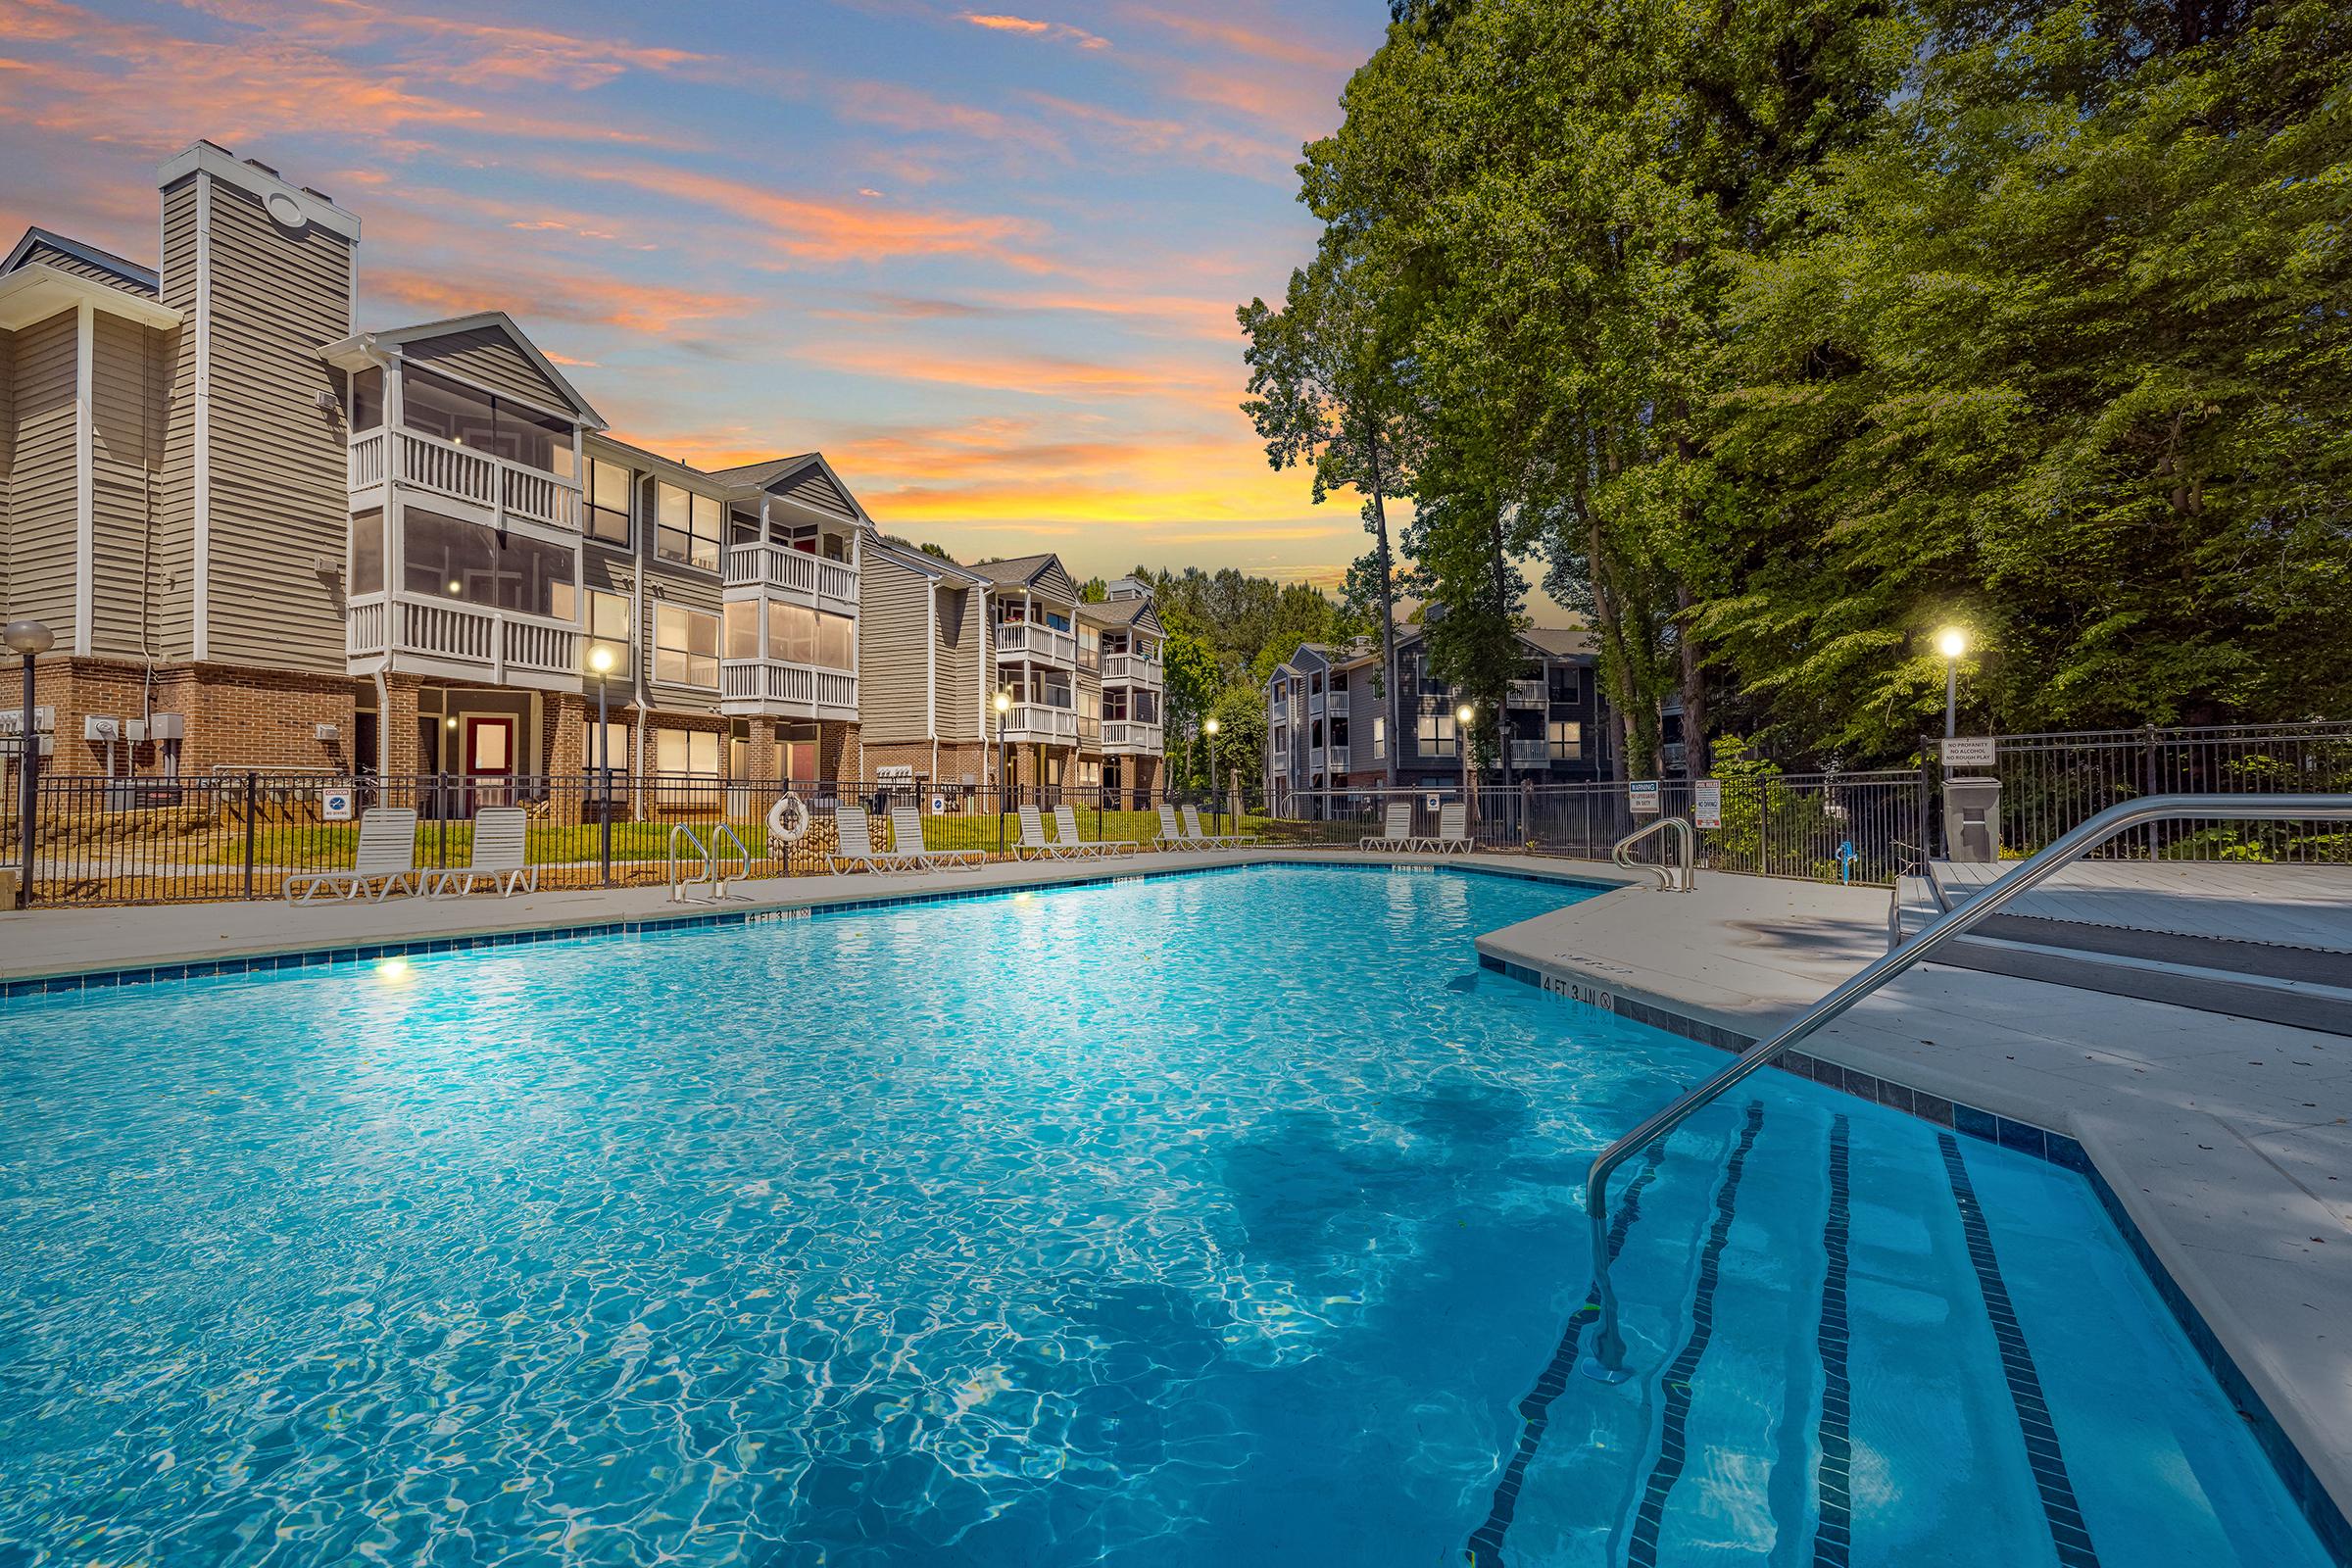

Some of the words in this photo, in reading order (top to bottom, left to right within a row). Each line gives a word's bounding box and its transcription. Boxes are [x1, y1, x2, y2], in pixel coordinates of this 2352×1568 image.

[1632, 783, 1655, 792] WARNING
[749, 913, 755, 921] 4
[760, 911, 771, 921] FT
[777, 910, 782, 919] 3
[787, 909, 796, 918] IN
[1544, 977, 1550, 991] 4
[1555, 979, 1566, 996] FT
[1572, 985, 1578, 1000] 3
[1584, 987, 1595, 1005] IN
